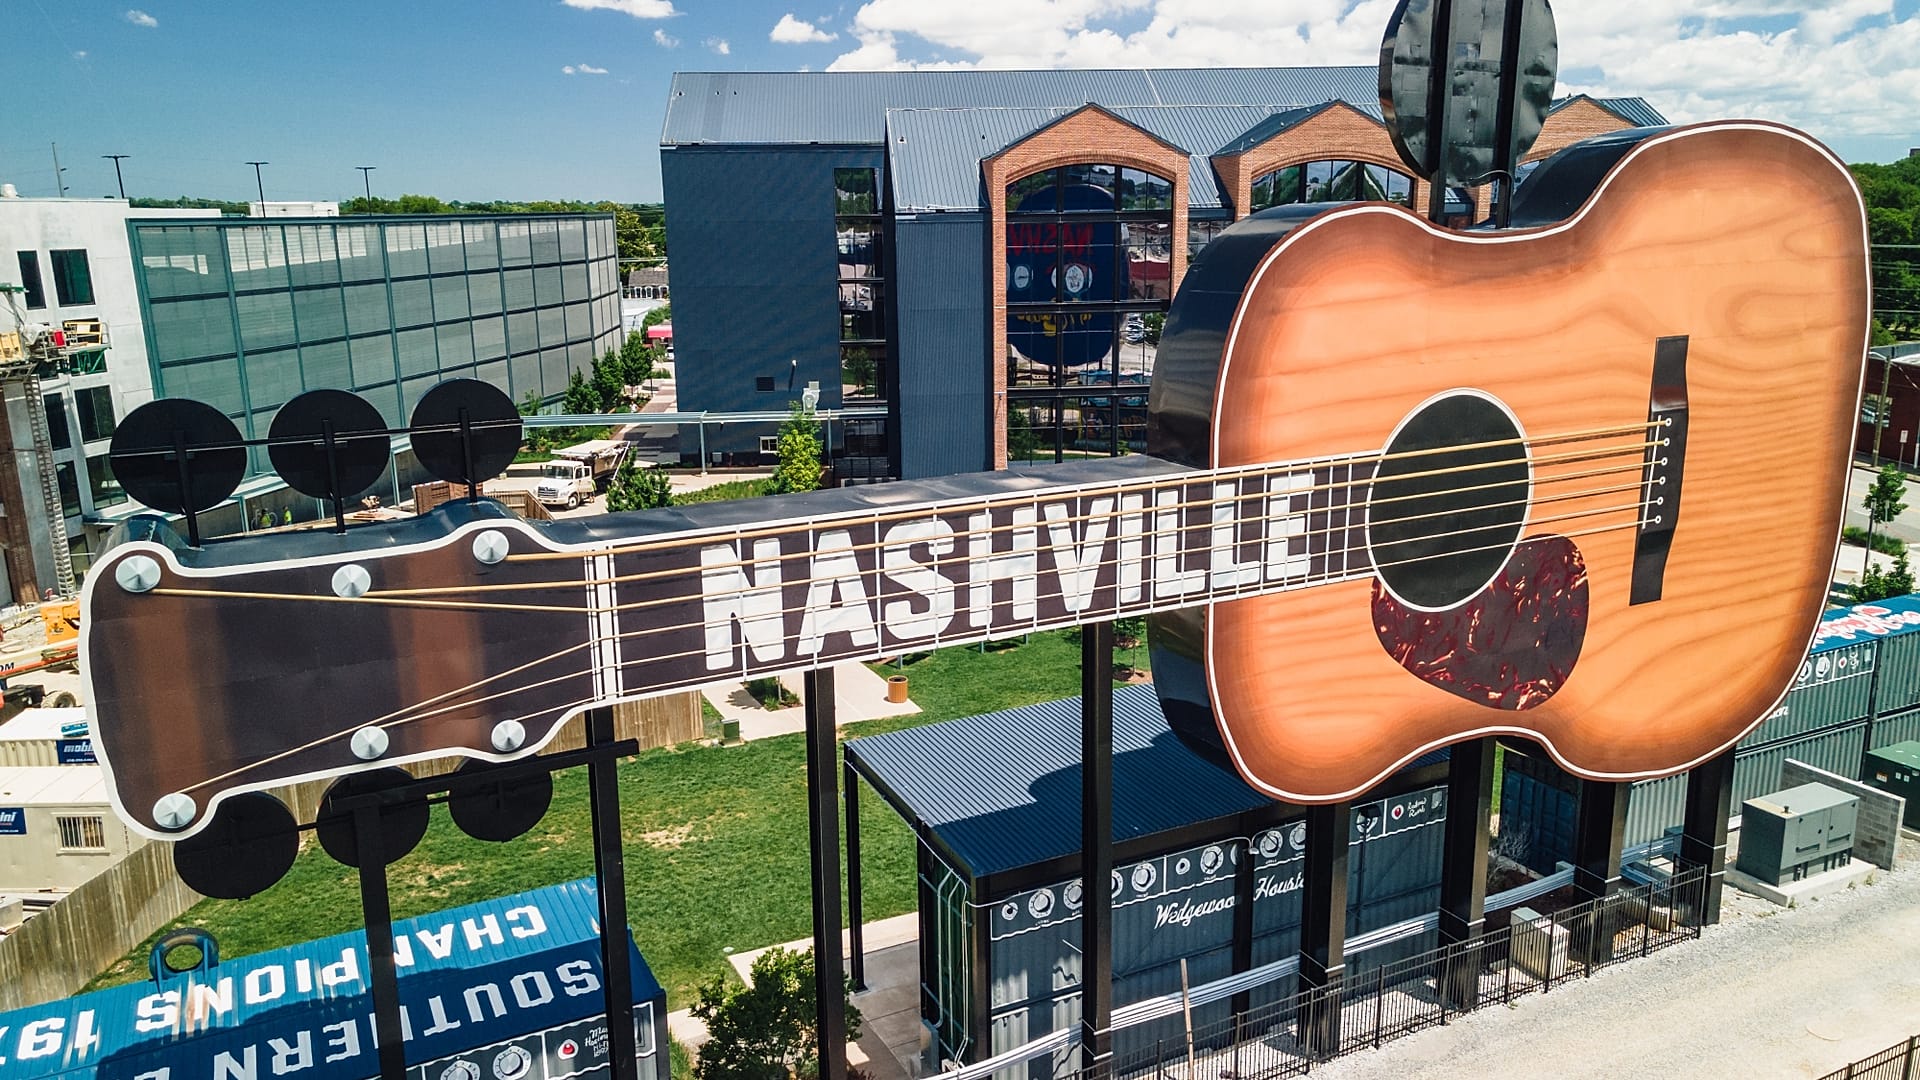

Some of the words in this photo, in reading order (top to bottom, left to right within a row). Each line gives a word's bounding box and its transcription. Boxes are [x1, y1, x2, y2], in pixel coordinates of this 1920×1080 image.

[700, 473, 1316, 671] NASHVILLE
[63, 741, 94, 752] mobi
[0, 811, 17, 822] ini
[1153, 896, 1236, 929] Wedgewoo
[1253, 871, 1304, 901] Houst
[0, 1009, 100, 1064] 19
